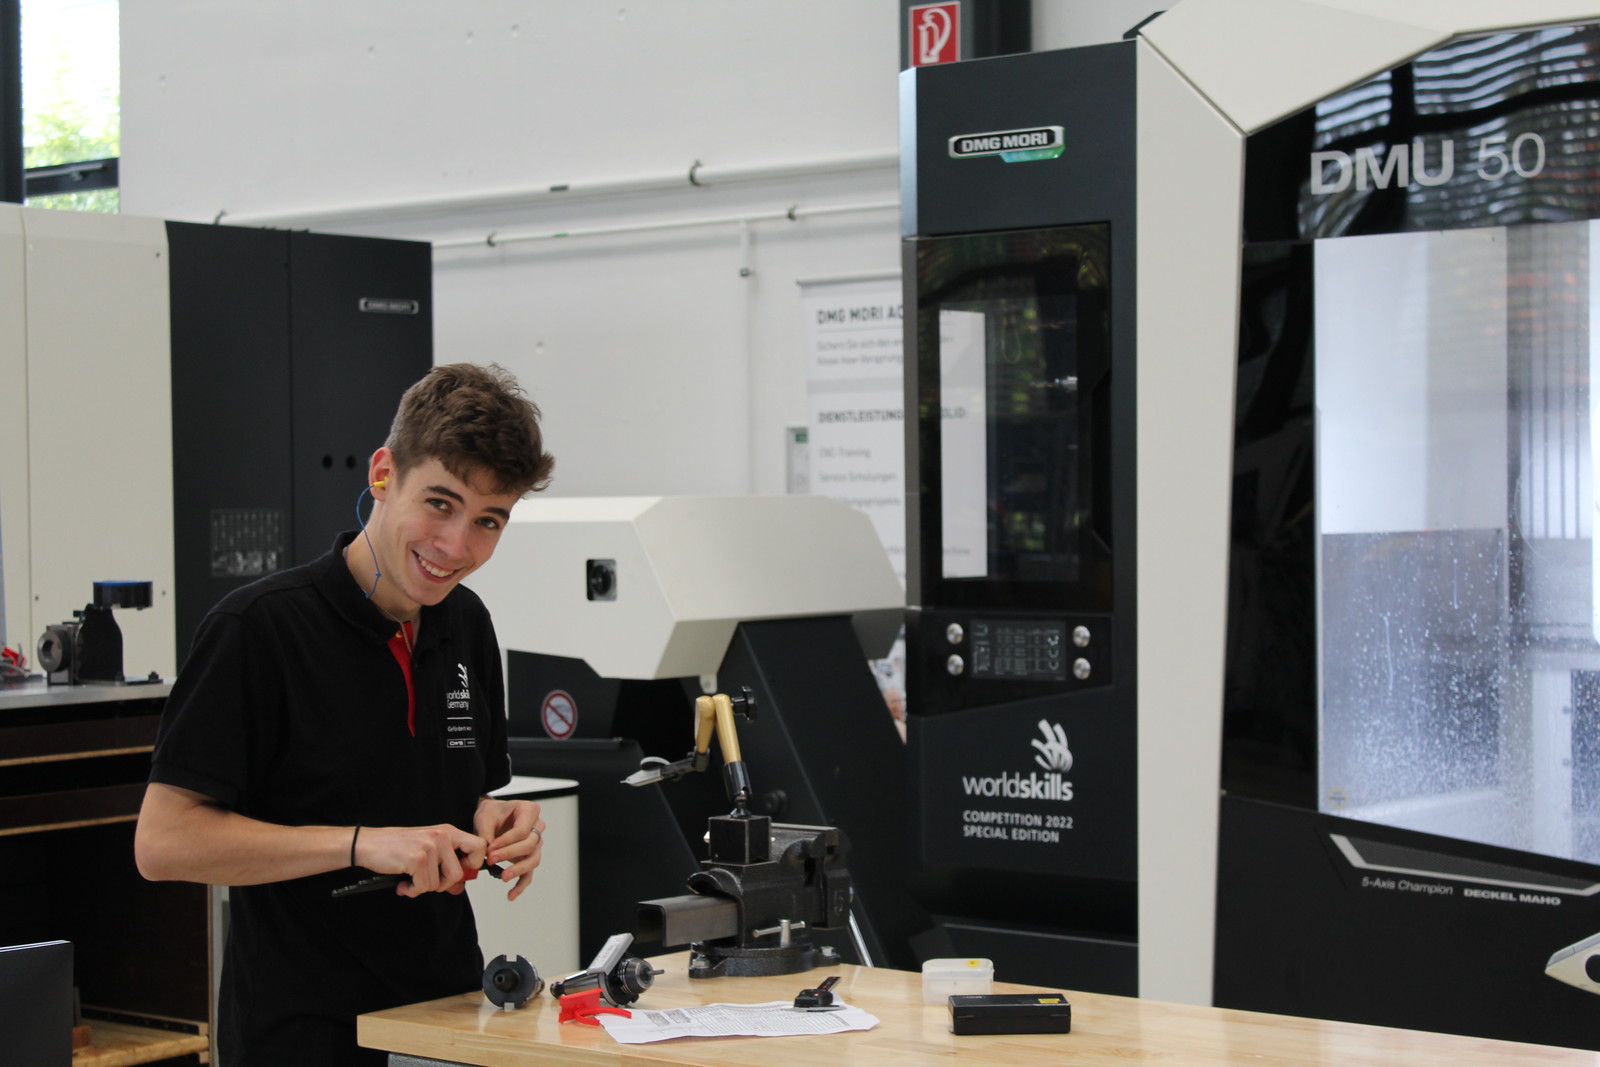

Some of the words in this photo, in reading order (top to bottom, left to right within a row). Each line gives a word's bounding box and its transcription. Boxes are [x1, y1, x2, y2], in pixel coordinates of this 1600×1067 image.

[962, 137, 1001, 153] DMG
[1002, 132, 1048, 149] MORI
[1310, 139, 1454, 195] DMU
[1477, 132, 1546, 181] 50
[817, 309, 846, 325] DMG
[850, 306, 883, 323] MORI
[962, 771, 1073, 801] worldskills
[962, 810, 1042, 827] COMPETITION
[1045, 815, 1073, 829] 2022
[963, 825, 1008, 840] SPECIAL
[1011, 828, 1060, 843] EDITION
[1361, 876, 1395, 890] 5-Axis
[1398, 880, 1453, 895] Champion
[1463, 888, 1517, 902] DECKEL
[1519, 894, 1561, 906] MAHO
